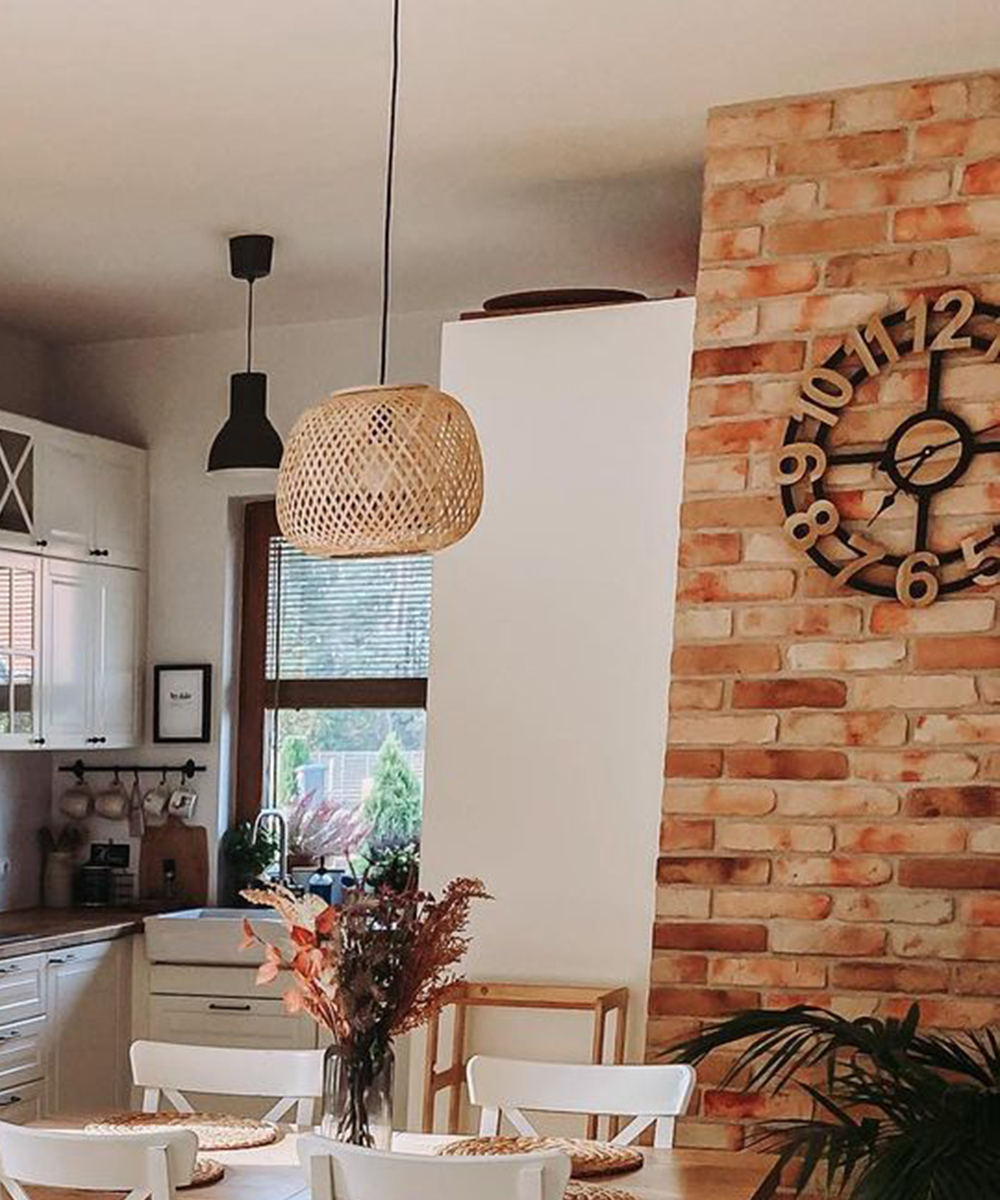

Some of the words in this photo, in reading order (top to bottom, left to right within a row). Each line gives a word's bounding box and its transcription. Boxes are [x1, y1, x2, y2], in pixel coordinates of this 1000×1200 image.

[844, 312, 900, 377] 11
[905, 289, 975, 354] 12
[793, 367, 854, 427] 10
[776, 442, 827, 486] 9
[783, 499, 840, 551] 8
[833, 533, 885, 588] 7
[895, 551, 940, 609] 6
[961, 526, 1000, 586] 5
